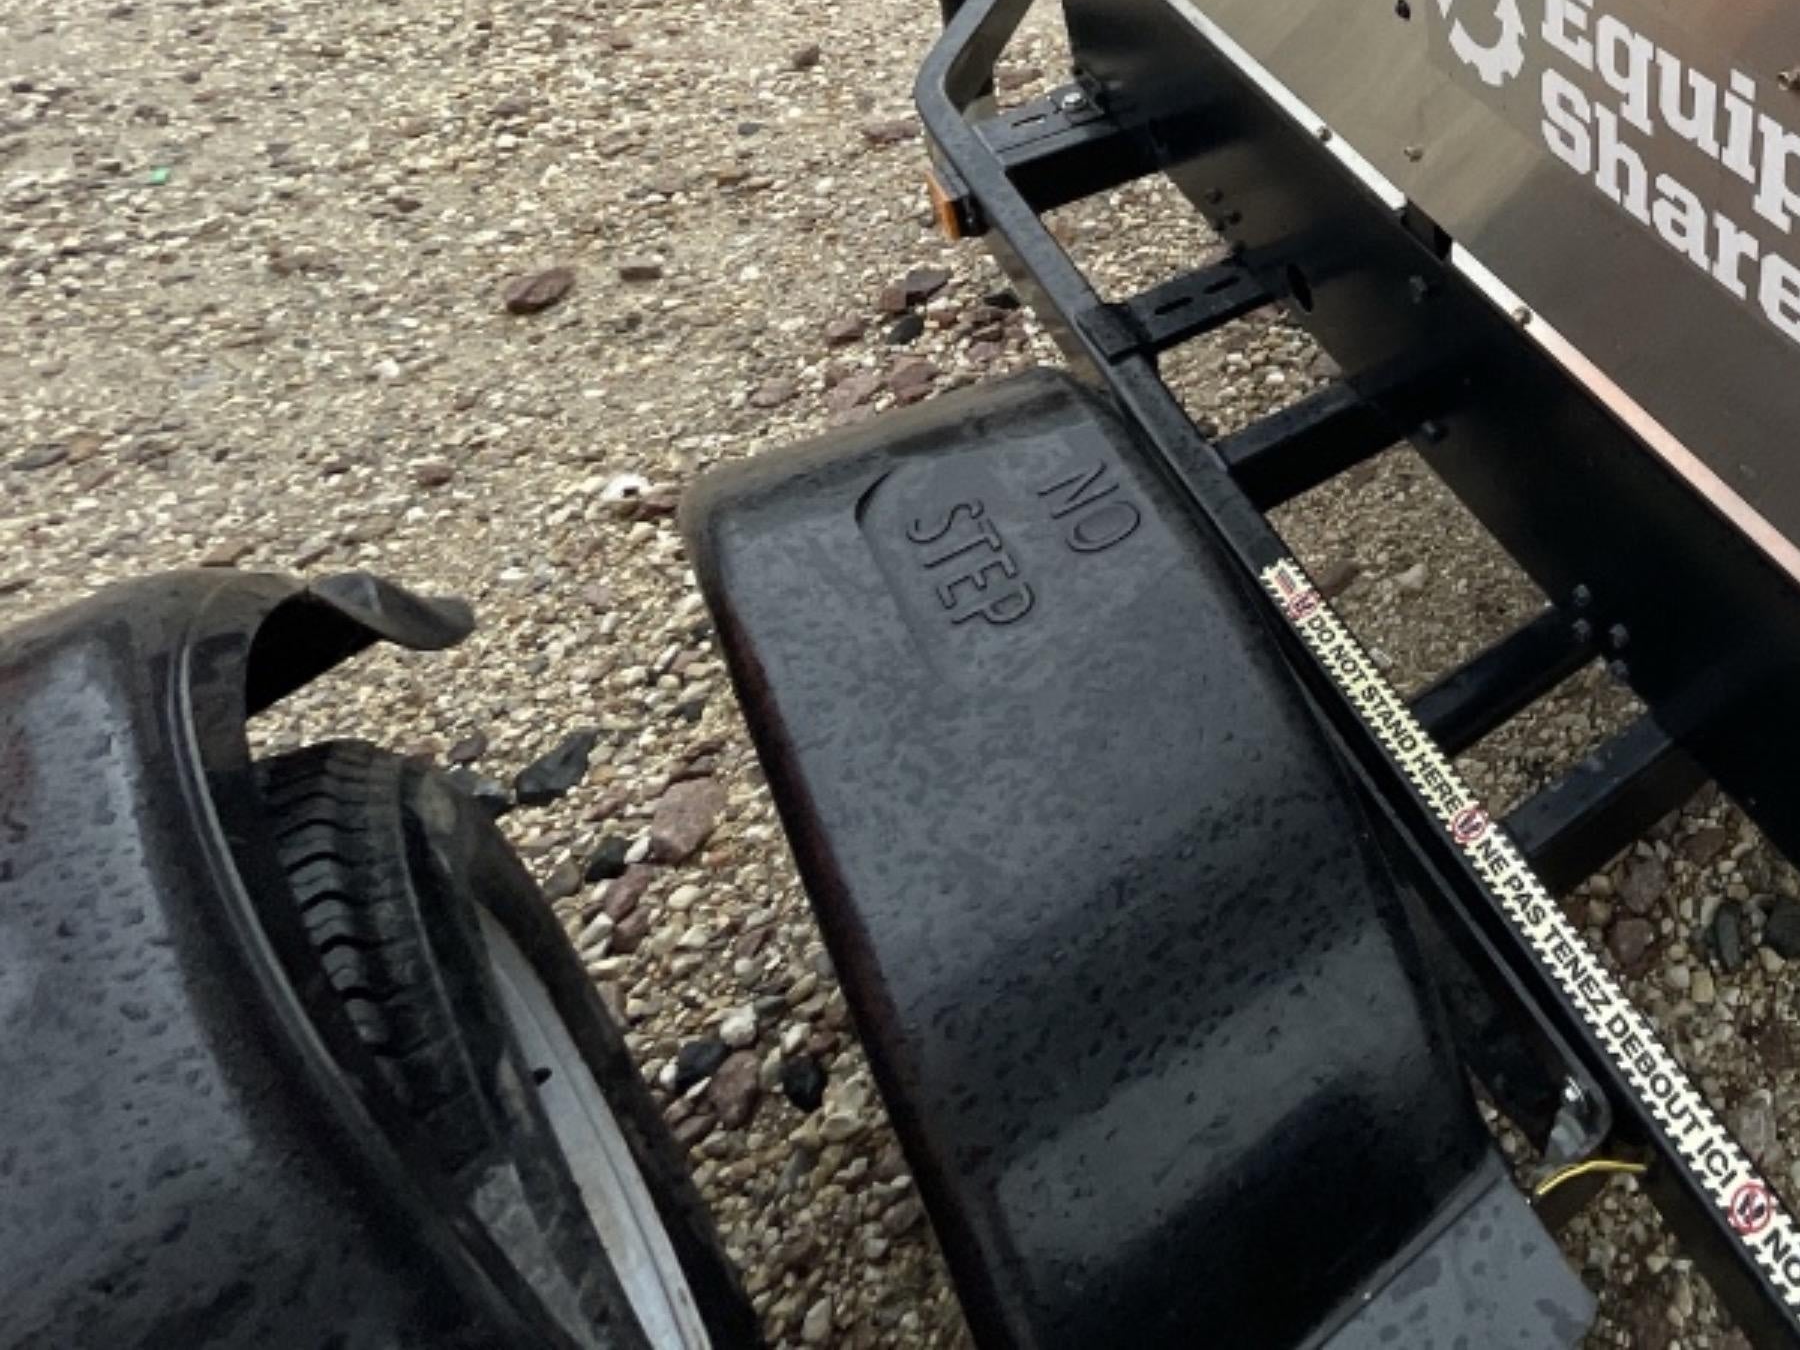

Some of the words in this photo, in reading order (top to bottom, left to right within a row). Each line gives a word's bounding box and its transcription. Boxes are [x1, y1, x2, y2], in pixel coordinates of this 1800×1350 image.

[905, 499, 1037, 626] STEP
[1036, 461, 1142, 554] NO
[1307, 615, 1336, 645] DO
[1329, 643, 1370, 683] NOT
[1360, 681, 1418, 752] STAND
[1411, 749, 1465, 814] HERE
[1475, 837, 1510, 876] NE
[1502, 870, 1547, 925] PAS
[1542, 921, 1612, 1017] TENEZ
[1604, 1011, 1706, 1137] DEBOUT
[1696, 1136, 1740, 1189] ICI
